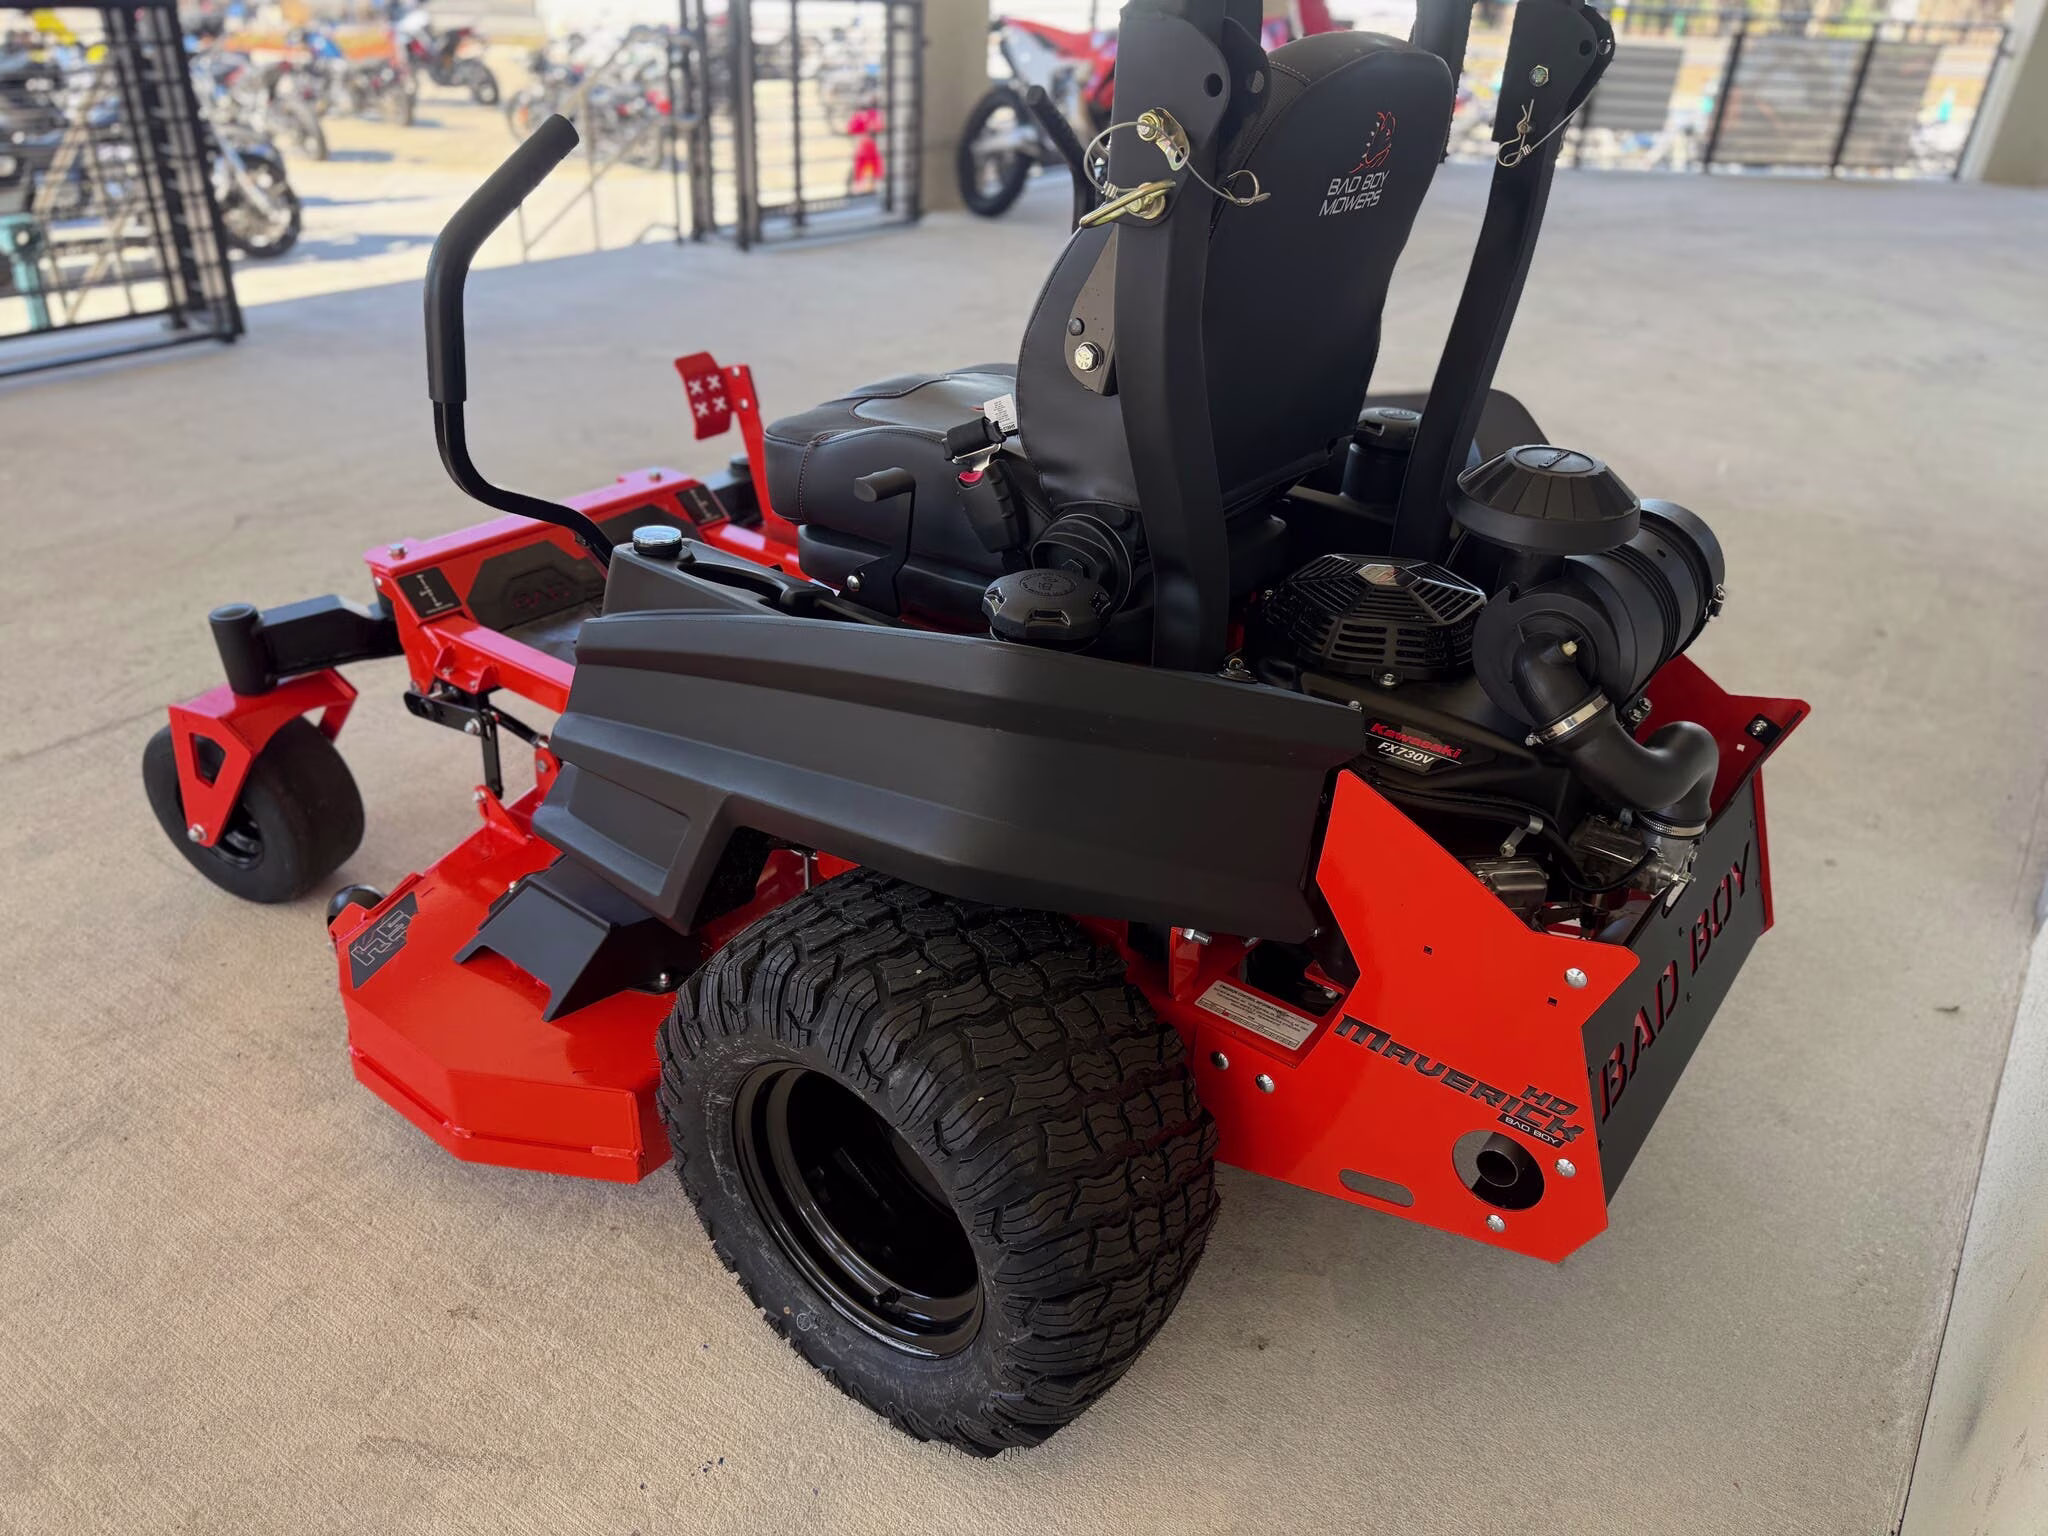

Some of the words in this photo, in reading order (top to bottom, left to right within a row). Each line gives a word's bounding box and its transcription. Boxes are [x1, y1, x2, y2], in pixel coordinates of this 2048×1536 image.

[1327, 175, 1361, 196] BAD
[1361, 170, 1390, 191] BOY
[1319, 189, 1383, 216] MOWERS
[1370, 723, 1462, 759] Kawasaki
[1377, 742, 1434, 764] FX730V
[1600, 960, 1679, 1124] BAD
[1690, 841, 1750, 976] BOY
[1334, 1014, 1585, 1143] MAVERICK
[1520, 1085, 1579, 1116] HD
[1505, 1116, 1531, 1133] BAD
[1533, 1130, 1559, 1145] BOY
